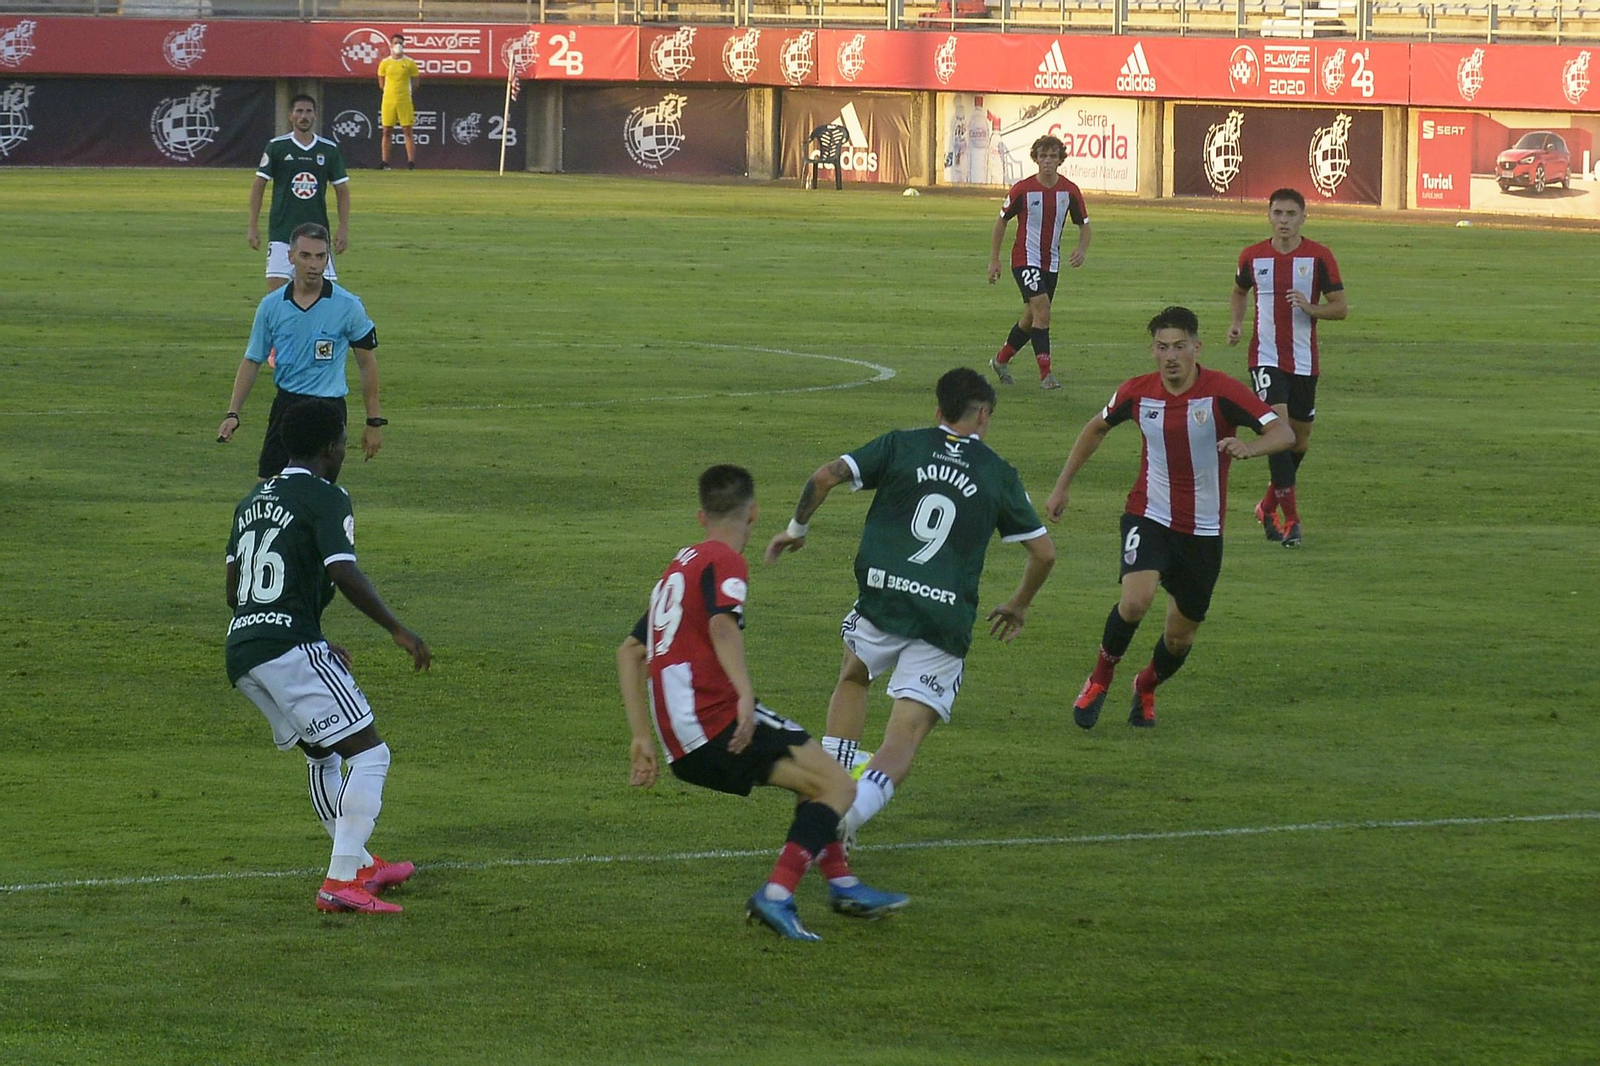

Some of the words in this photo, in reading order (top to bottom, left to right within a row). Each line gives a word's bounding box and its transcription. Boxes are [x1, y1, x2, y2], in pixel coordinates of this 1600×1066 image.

[1264, 52, 1310, 67] PLAYOFF
[1034, 71, 1073, 90] adidas
[1116, 73, 1156, 92] adidas
[1269, 79, 1305, 95] 2020
[1077, 109, 1108, 127] Sierra
[1436, 126, 1466, 136] SEAT
[1068, 164, 1099, 178] Mineral
[1100, 166, 1128, 180] Natural
[1422, 172, 1453, 190] Turial
[1021, 268, 1041, 287] 22
[1252, 367, 1272, 392] 16
[916, 464, 978, 498] AQUINO
[238, 502, 294, 533] ADILSON
[907, 493, 957, 566] 9
[1125, 526, 1141, 551] 6
[236, 527, 285, 606] 16
[887, 575, 957, 605] BESOCCER
[646, 571, 686, 664] 19
[305, 714, 340, 737] elfaro
